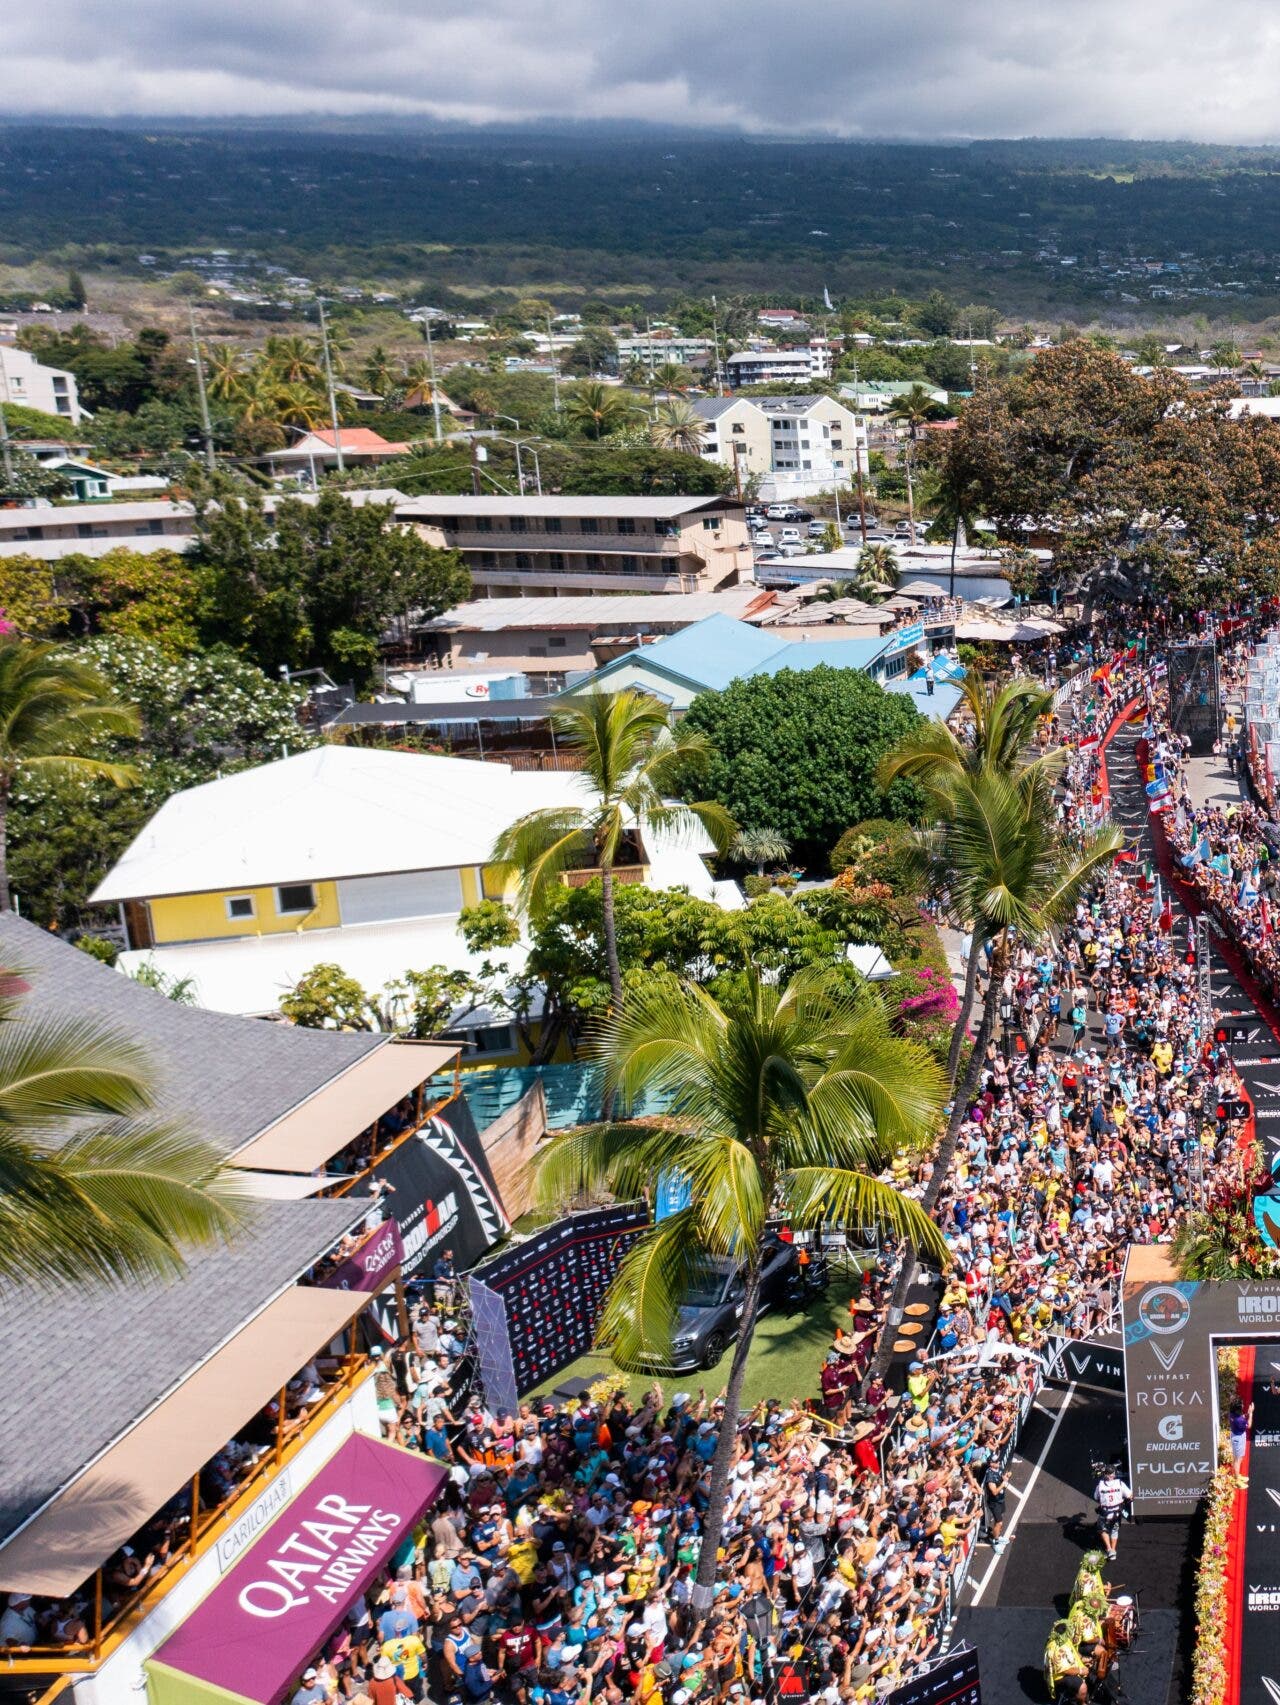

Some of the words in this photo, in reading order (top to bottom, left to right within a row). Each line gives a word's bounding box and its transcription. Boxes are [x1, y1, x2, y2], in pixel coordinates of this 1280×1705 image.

[400, 1192, 459, 1263] RONMAN
[1239, 1314, 1273, 1323] WORLD
[1146, 1373, 1190, 1381] VINFAST
[1146, 1442, 1201, 1451] ENDURANCE
[1136, 1461, 1210, 1474] FULGAZ
[222, 1491, 281, 1561] CARILOHA
[238, 1494, 372, 1618] QATAR
[313, 1509, 401, 1604] AIRWAYS
